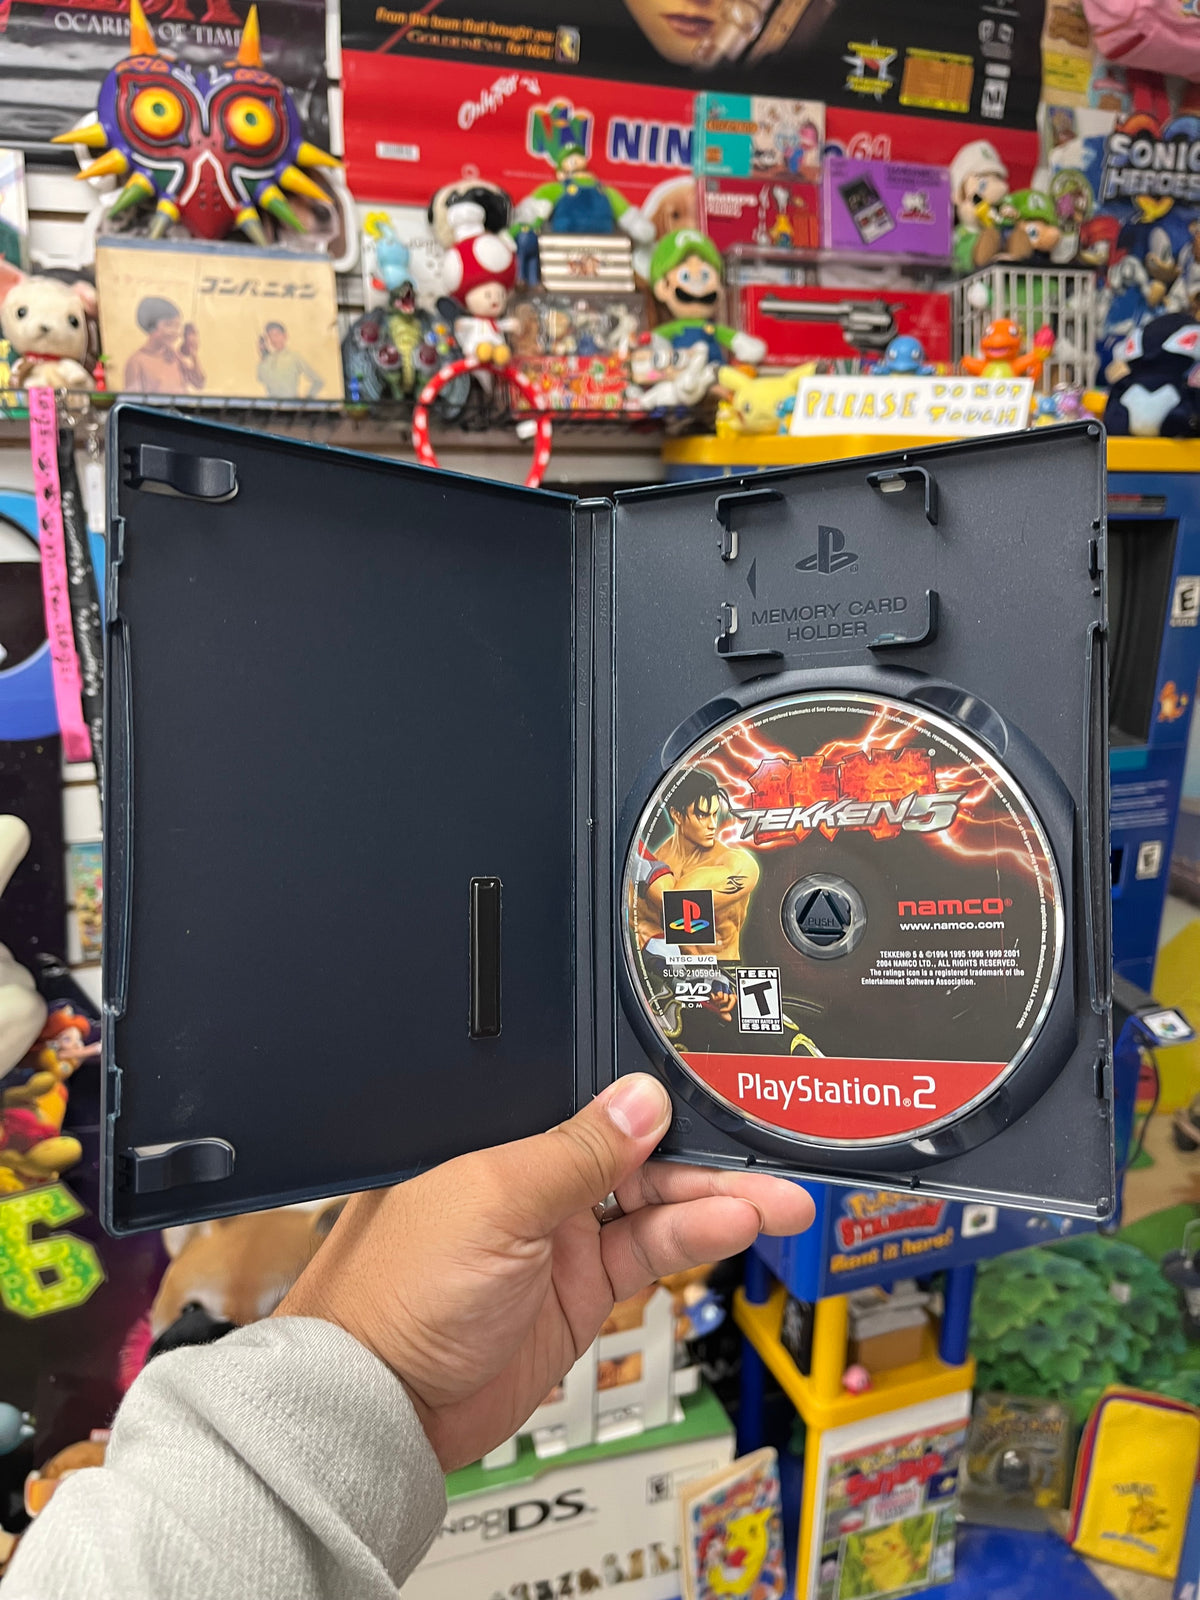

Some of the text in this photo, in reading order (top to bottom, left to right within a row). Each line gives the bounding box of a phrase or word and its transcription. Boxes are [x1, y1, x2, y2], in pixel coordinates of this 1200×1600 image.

[54, 11, 154, 37] OCARI
[806, 390, 917, 418] PLEASE
[751, 596, 908, 627] MEMORY CARD
[786, 620, 869, 643] HOLDER
[808, 917, 836, 927] PUSH
[900, 920, 1005, 931] www.namco.com
[950, 950, 966, 958] 1995
[876, 959, 892, 968] 2004
[893, 959, 918, 968] NAMCO
[937, 959, 951, 968] ALL
[952, 958, 978, 968] RIGHTS
[979, 958, 1019, 968] RESERVED.
[662, 968, 685, 978] SLUS
[738, 970, 778, 978] TEEN
[870, 968, 882, 976] The
[883, 968, 906, 978] ratings
[906, 968, 920, 976] icon
[921, 968, 928, 976] is
[934, 968, 968, 978] registered
[969, 968, 1004, 976] trademark
[1005, 968, 1012, 976] of
[1013, 968, 1025, 976] the
[861, 977, 977, 986] Entertainment Software Association.
[675, 982, 713, 996] DVD
[742, 980, 773, 1017] T
[508, 1487, 586, 1533] DS
